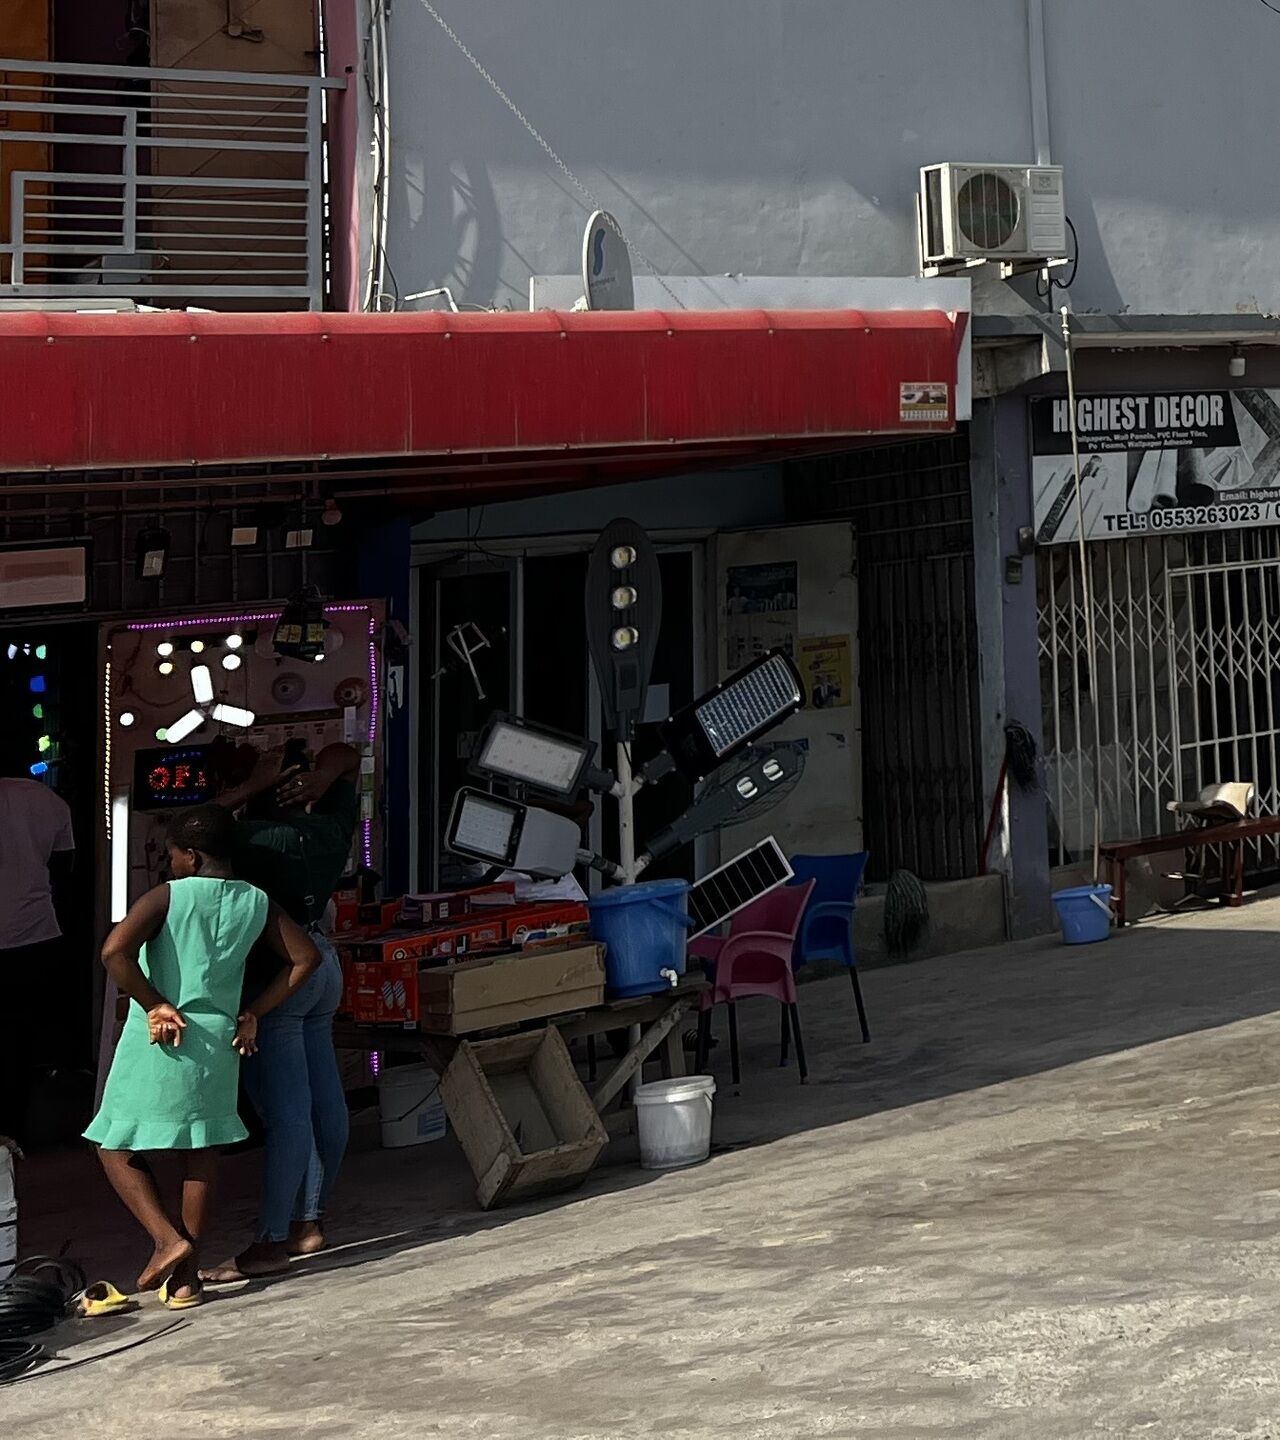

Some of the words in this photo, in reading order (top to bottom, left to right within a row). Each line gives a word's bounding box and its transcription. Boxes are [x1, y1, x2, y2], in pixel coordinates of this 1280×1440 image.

[1154, 395, 1224, 429] DECOR
[1073, 433, 1113, 444] allpapers,
[1220, 492, 1248, 502] Email:
[1103, 514, 1146, 531] TEL:
[1152, 504, 1260, 528] 0553263023
[1265, 503, 1270, 519] /
